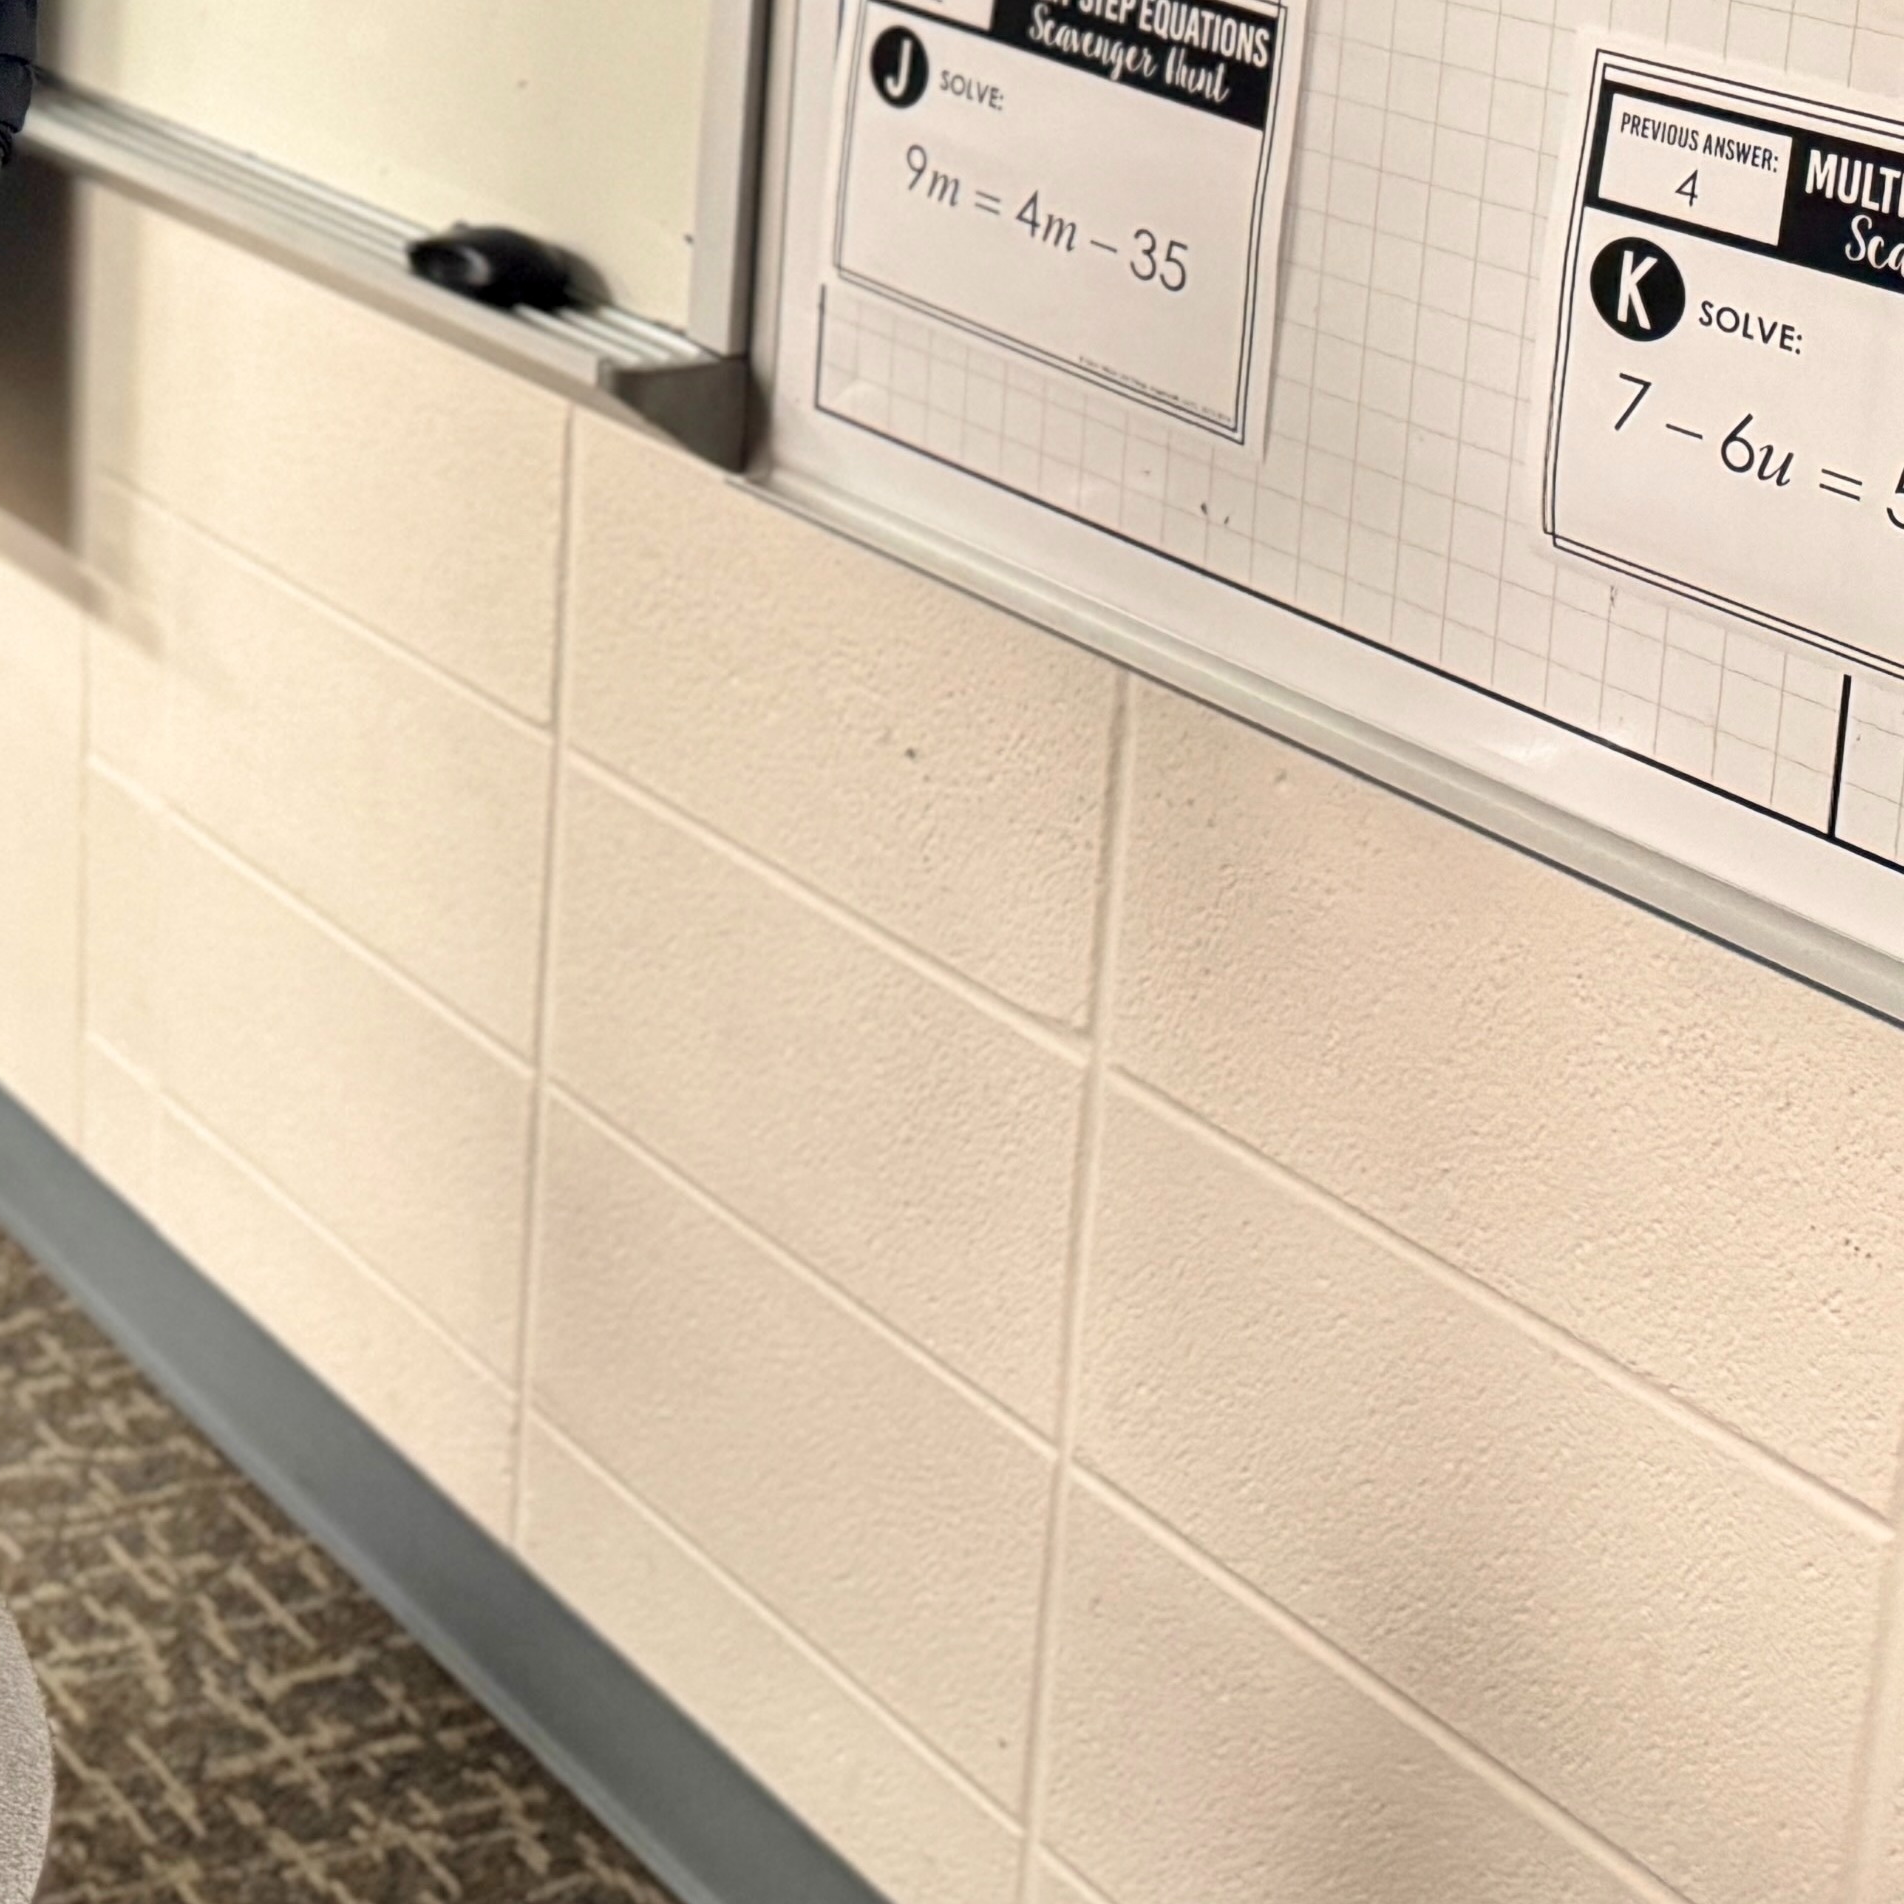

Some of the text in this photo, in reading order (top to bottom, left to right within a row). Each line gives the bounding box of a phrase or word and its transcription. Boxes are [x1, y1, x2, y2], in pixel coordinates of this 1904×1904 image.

[884, 37, 1006, 113] J SOLVE:
[1027, 2, 1231, 106] Scavenger Hunt
[1619, 110, 1780, 174] PREVIOUS ANSWER:
[1674, 167, 1701, 209] 4
[1616, 248, 1805, 357] K SOLVE:
